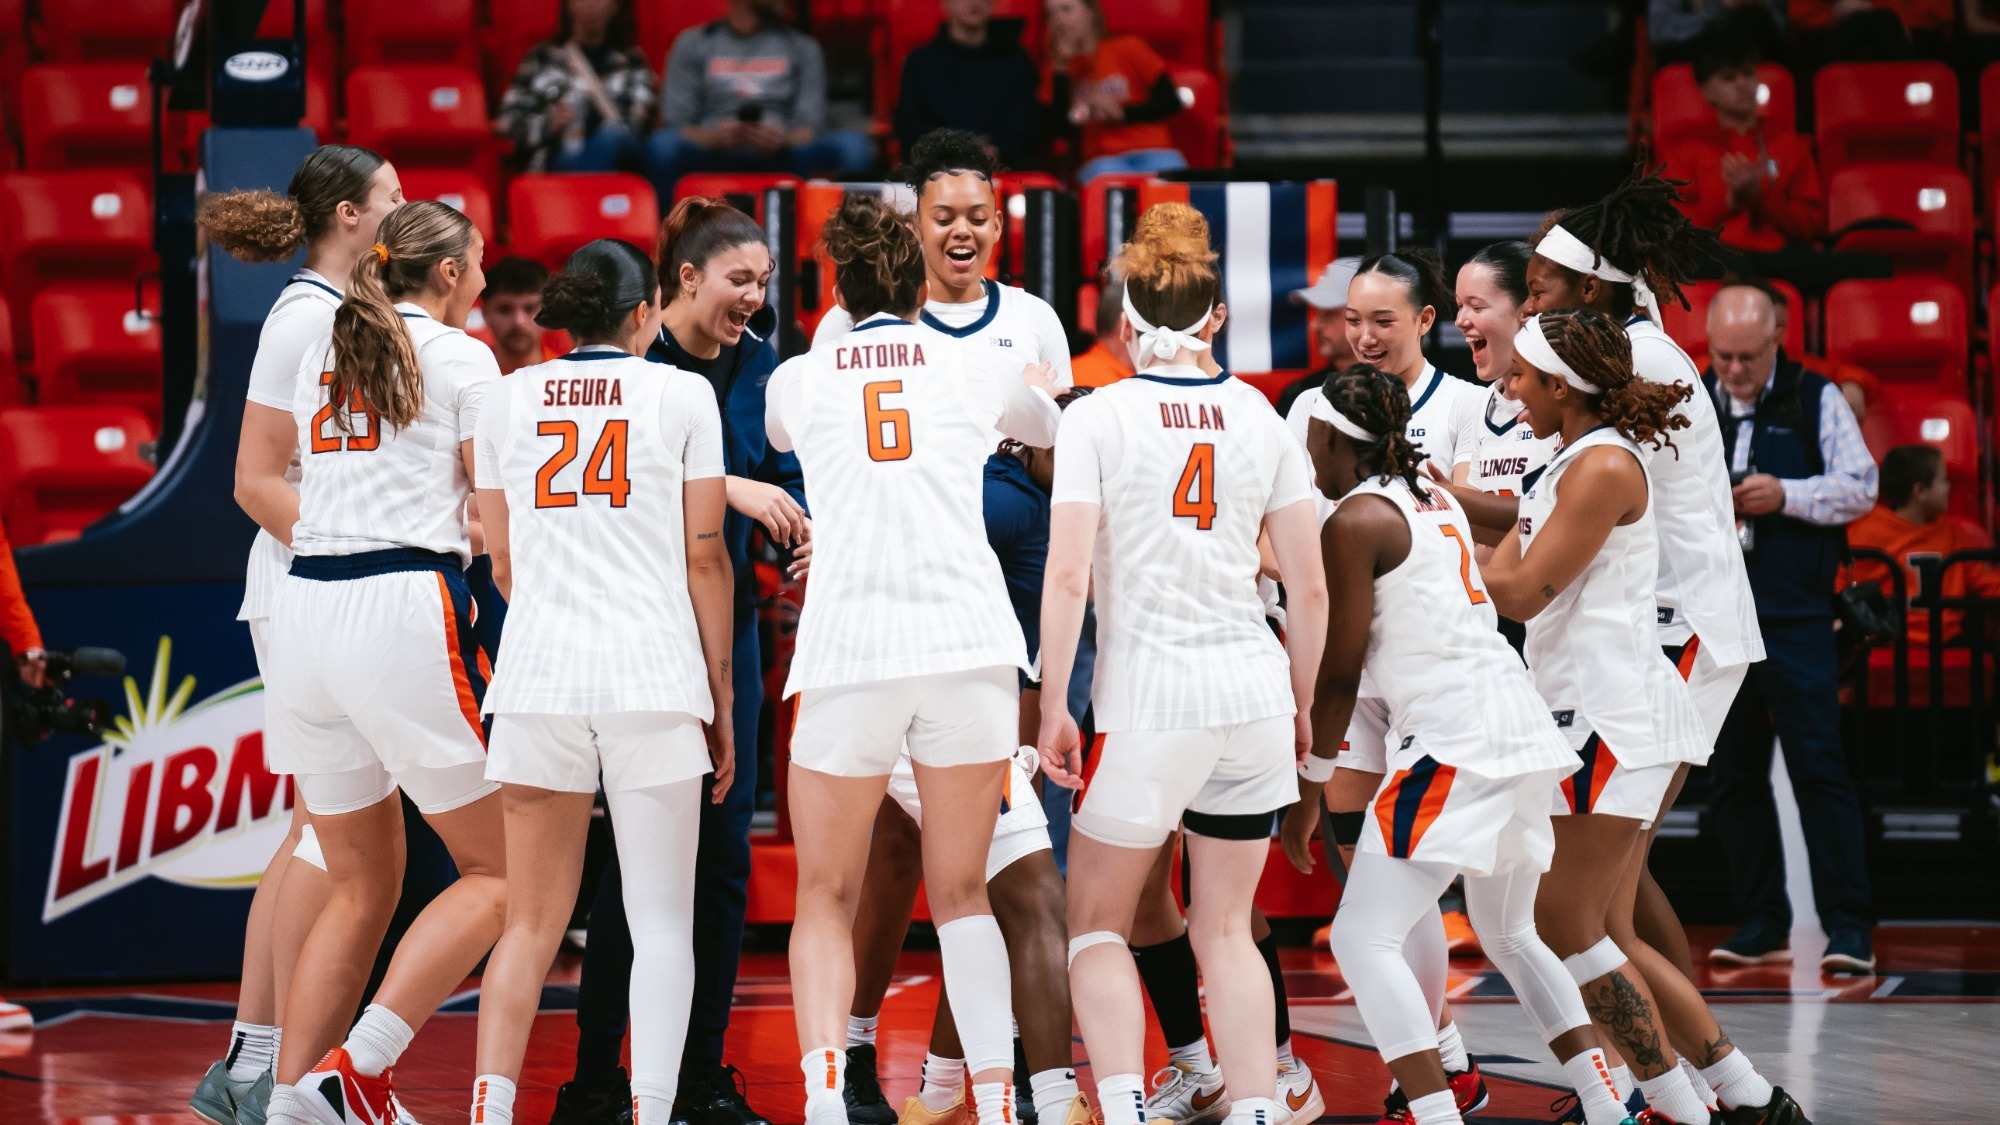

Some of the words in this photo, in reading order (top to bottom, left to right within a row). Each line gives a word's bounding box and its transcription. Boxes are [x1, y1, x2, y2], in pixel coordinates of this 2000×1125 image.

[543, 378, 622, 406] SEGURA
[836, 343, 926, 370] CATOIRA
[863, 379, 913, 462] 6
[1159, 401, 1226, 431] DOLAN
[535, 419, 631, 509] 24
[1172, 443, 1217, 530] 4
[54, 729, 294, 902] LIBM
